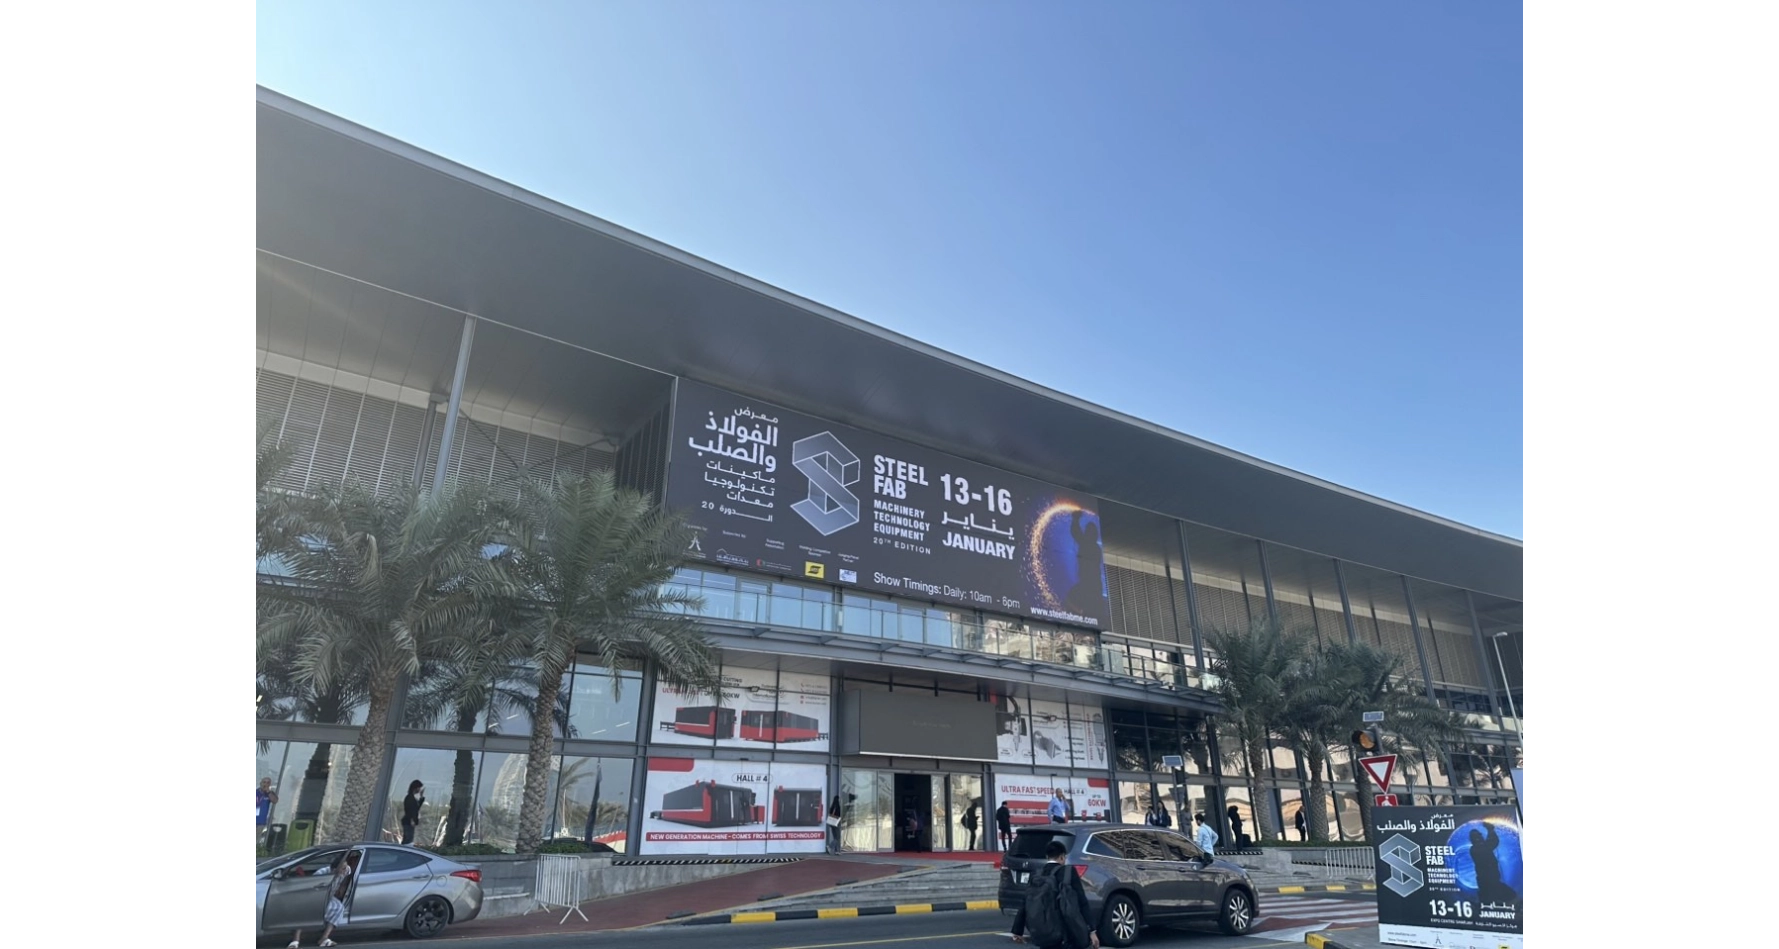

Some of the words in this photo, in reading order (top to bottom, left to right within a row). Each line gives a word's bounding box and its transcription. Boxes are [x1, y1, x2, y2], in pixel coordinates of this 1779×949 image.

[734, 406, 778, 424] معرض
[705, 411, 778, 446] الفولاذ
[688, 434, 776, 472] والصلب
[706, 460, 776, 484] ماكينات
[874, 454, 928, 486] STEEL
[704, 472, 775, 496] تكنولوجيا
[874, 474, 907, 500] FAB
[726, 491, 774, 508] معدات
[940, 474, 1013, 516] 13-16
[702, 500, 714, 510] 20
[720, 505, 773, 522] الدورة
[874, 500, 925, 519] MACHINERY
[874, 511, 930, 532] TECHNOLOGY
[941, 511, 1014, 541] يناير
[874, 522, 924, 542] EQUIPMENT
[894, 540, 931, 554] EDITION
[942, 532, 1015, 560] JANUARY
[874, 572, 900, 586] Show
[902, 578, 942, 595] Timings:
[944, 585, 967, 600] Daily:
[969, 590, 992, 604] 10am
[1002, 596, 1020, 608] 6pm
[1030, 606, 1098, 625] www.steelfabme.com
[736, 774, 754, 782] HALL
[1001, 785, 1021, 793] ULTRA
[1376, 820, 1417, 834] والصلب
[1420, 818, 1455, 833] الفولاذ
[1425, 845, 1456, 856] STEEL
[1426, 856, 1444, 865] FAB
[1430, 899, 1472, 918] 13-16
[1479, 910, 1515, 920] JANUARY
